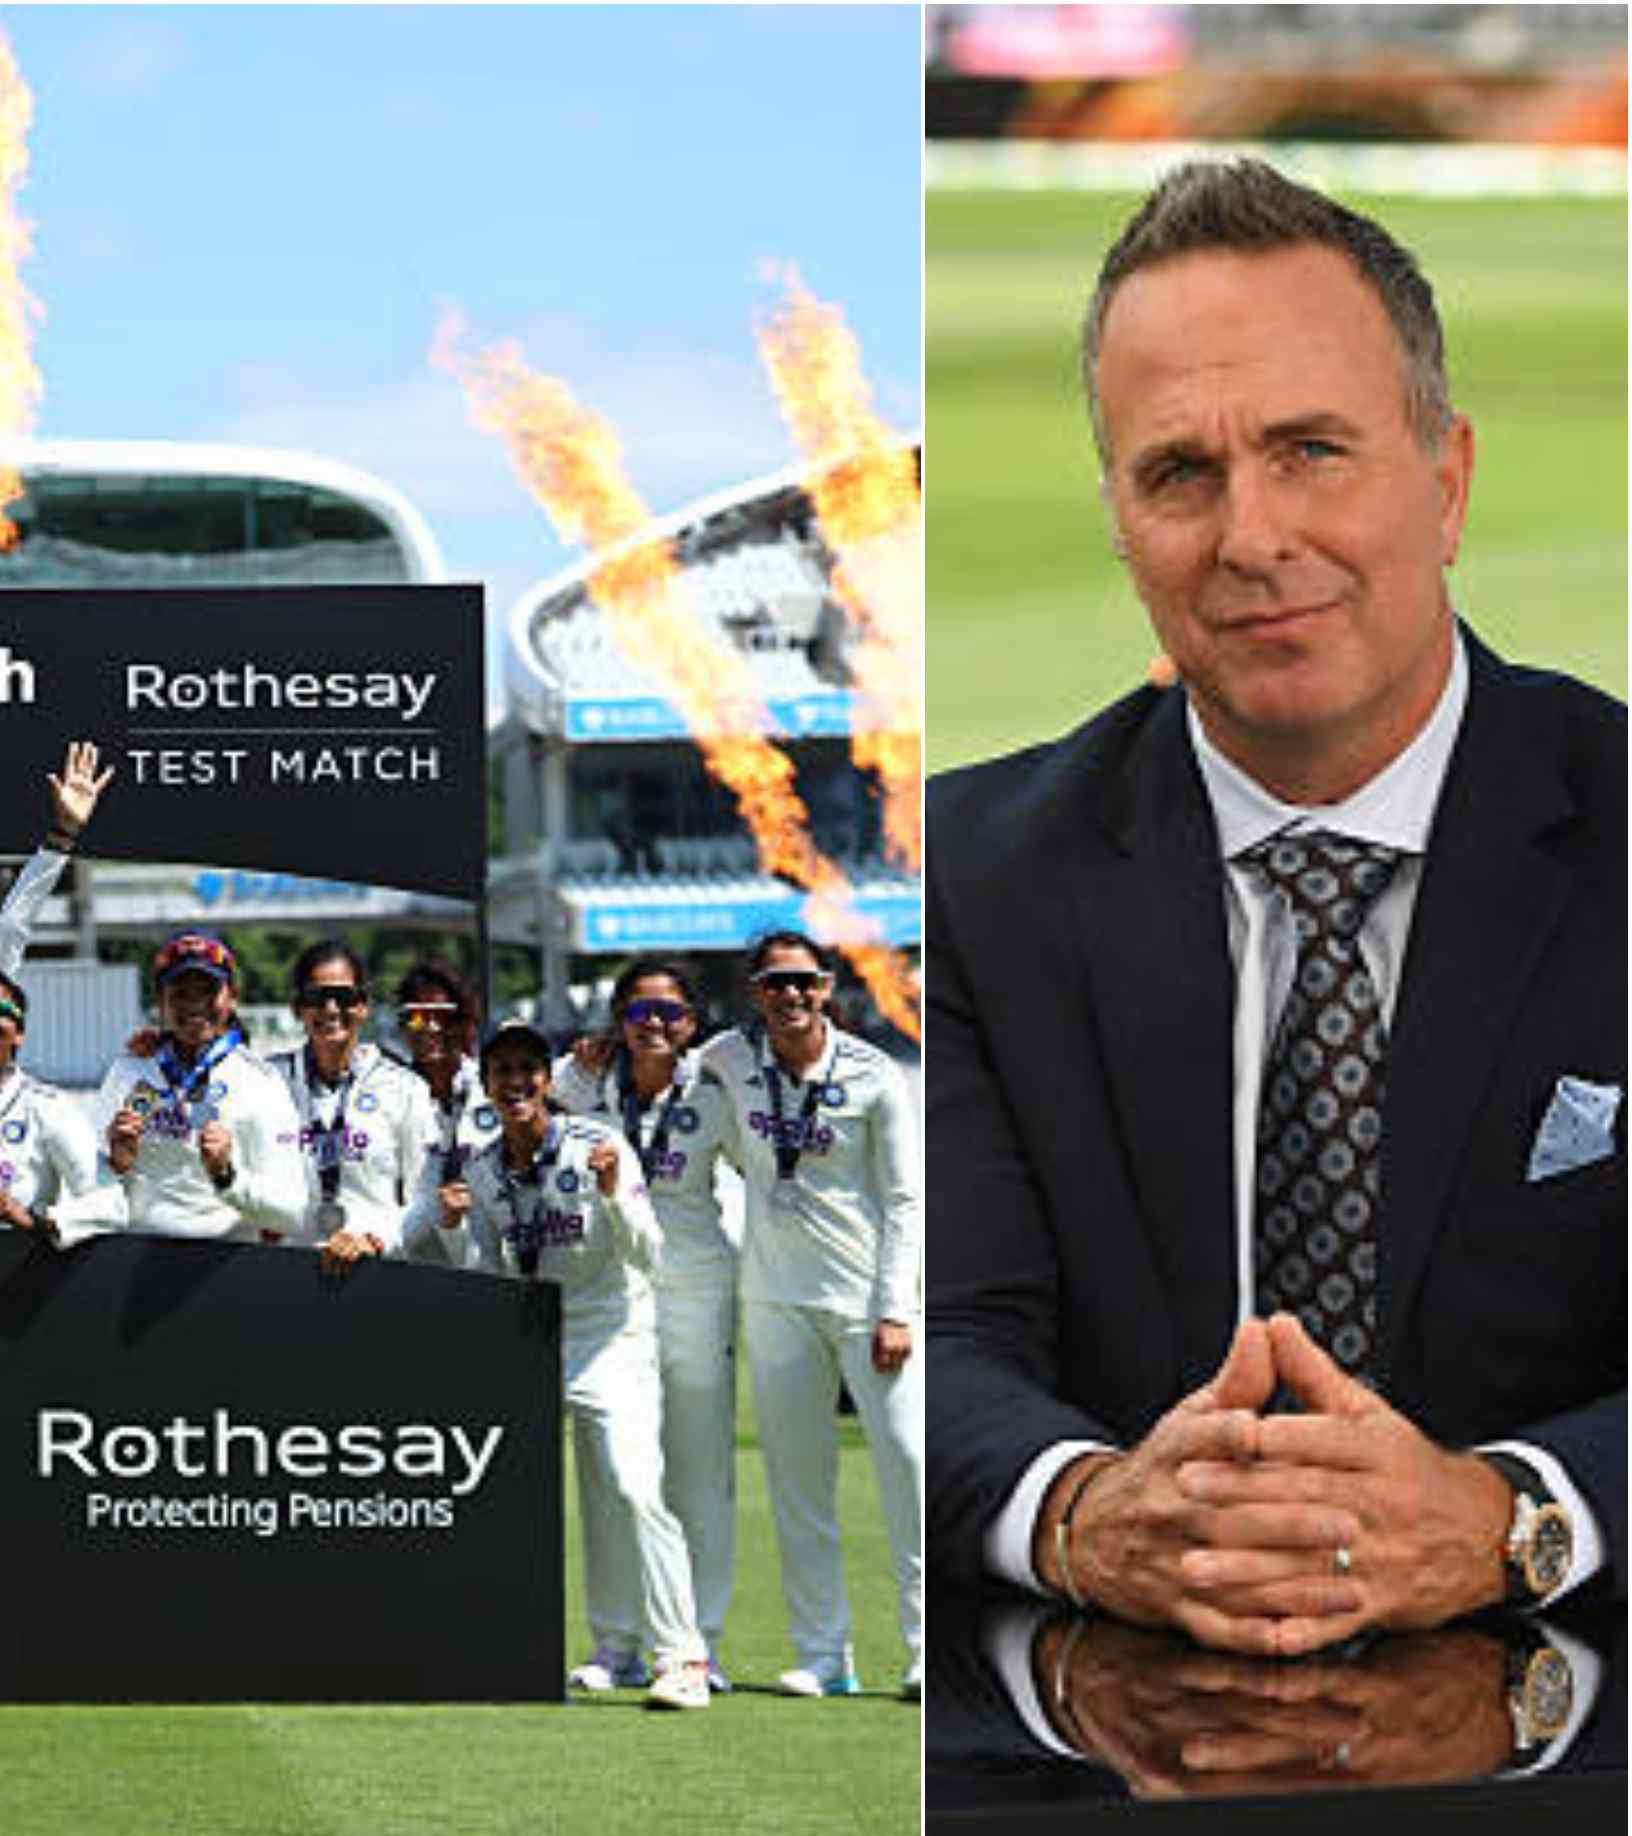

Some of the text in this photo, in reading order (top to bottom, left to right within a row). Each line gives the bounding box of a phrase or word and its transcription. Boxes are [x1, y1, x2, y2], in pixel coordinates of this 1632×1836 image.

[126, 663, 437, 719] Rothesay
[127, 746, 440, 784] TEST MATCH
[38, 1408, 504, 1495] Rothesay
[86, 1492, 455, 1537] Protecting Pensions
